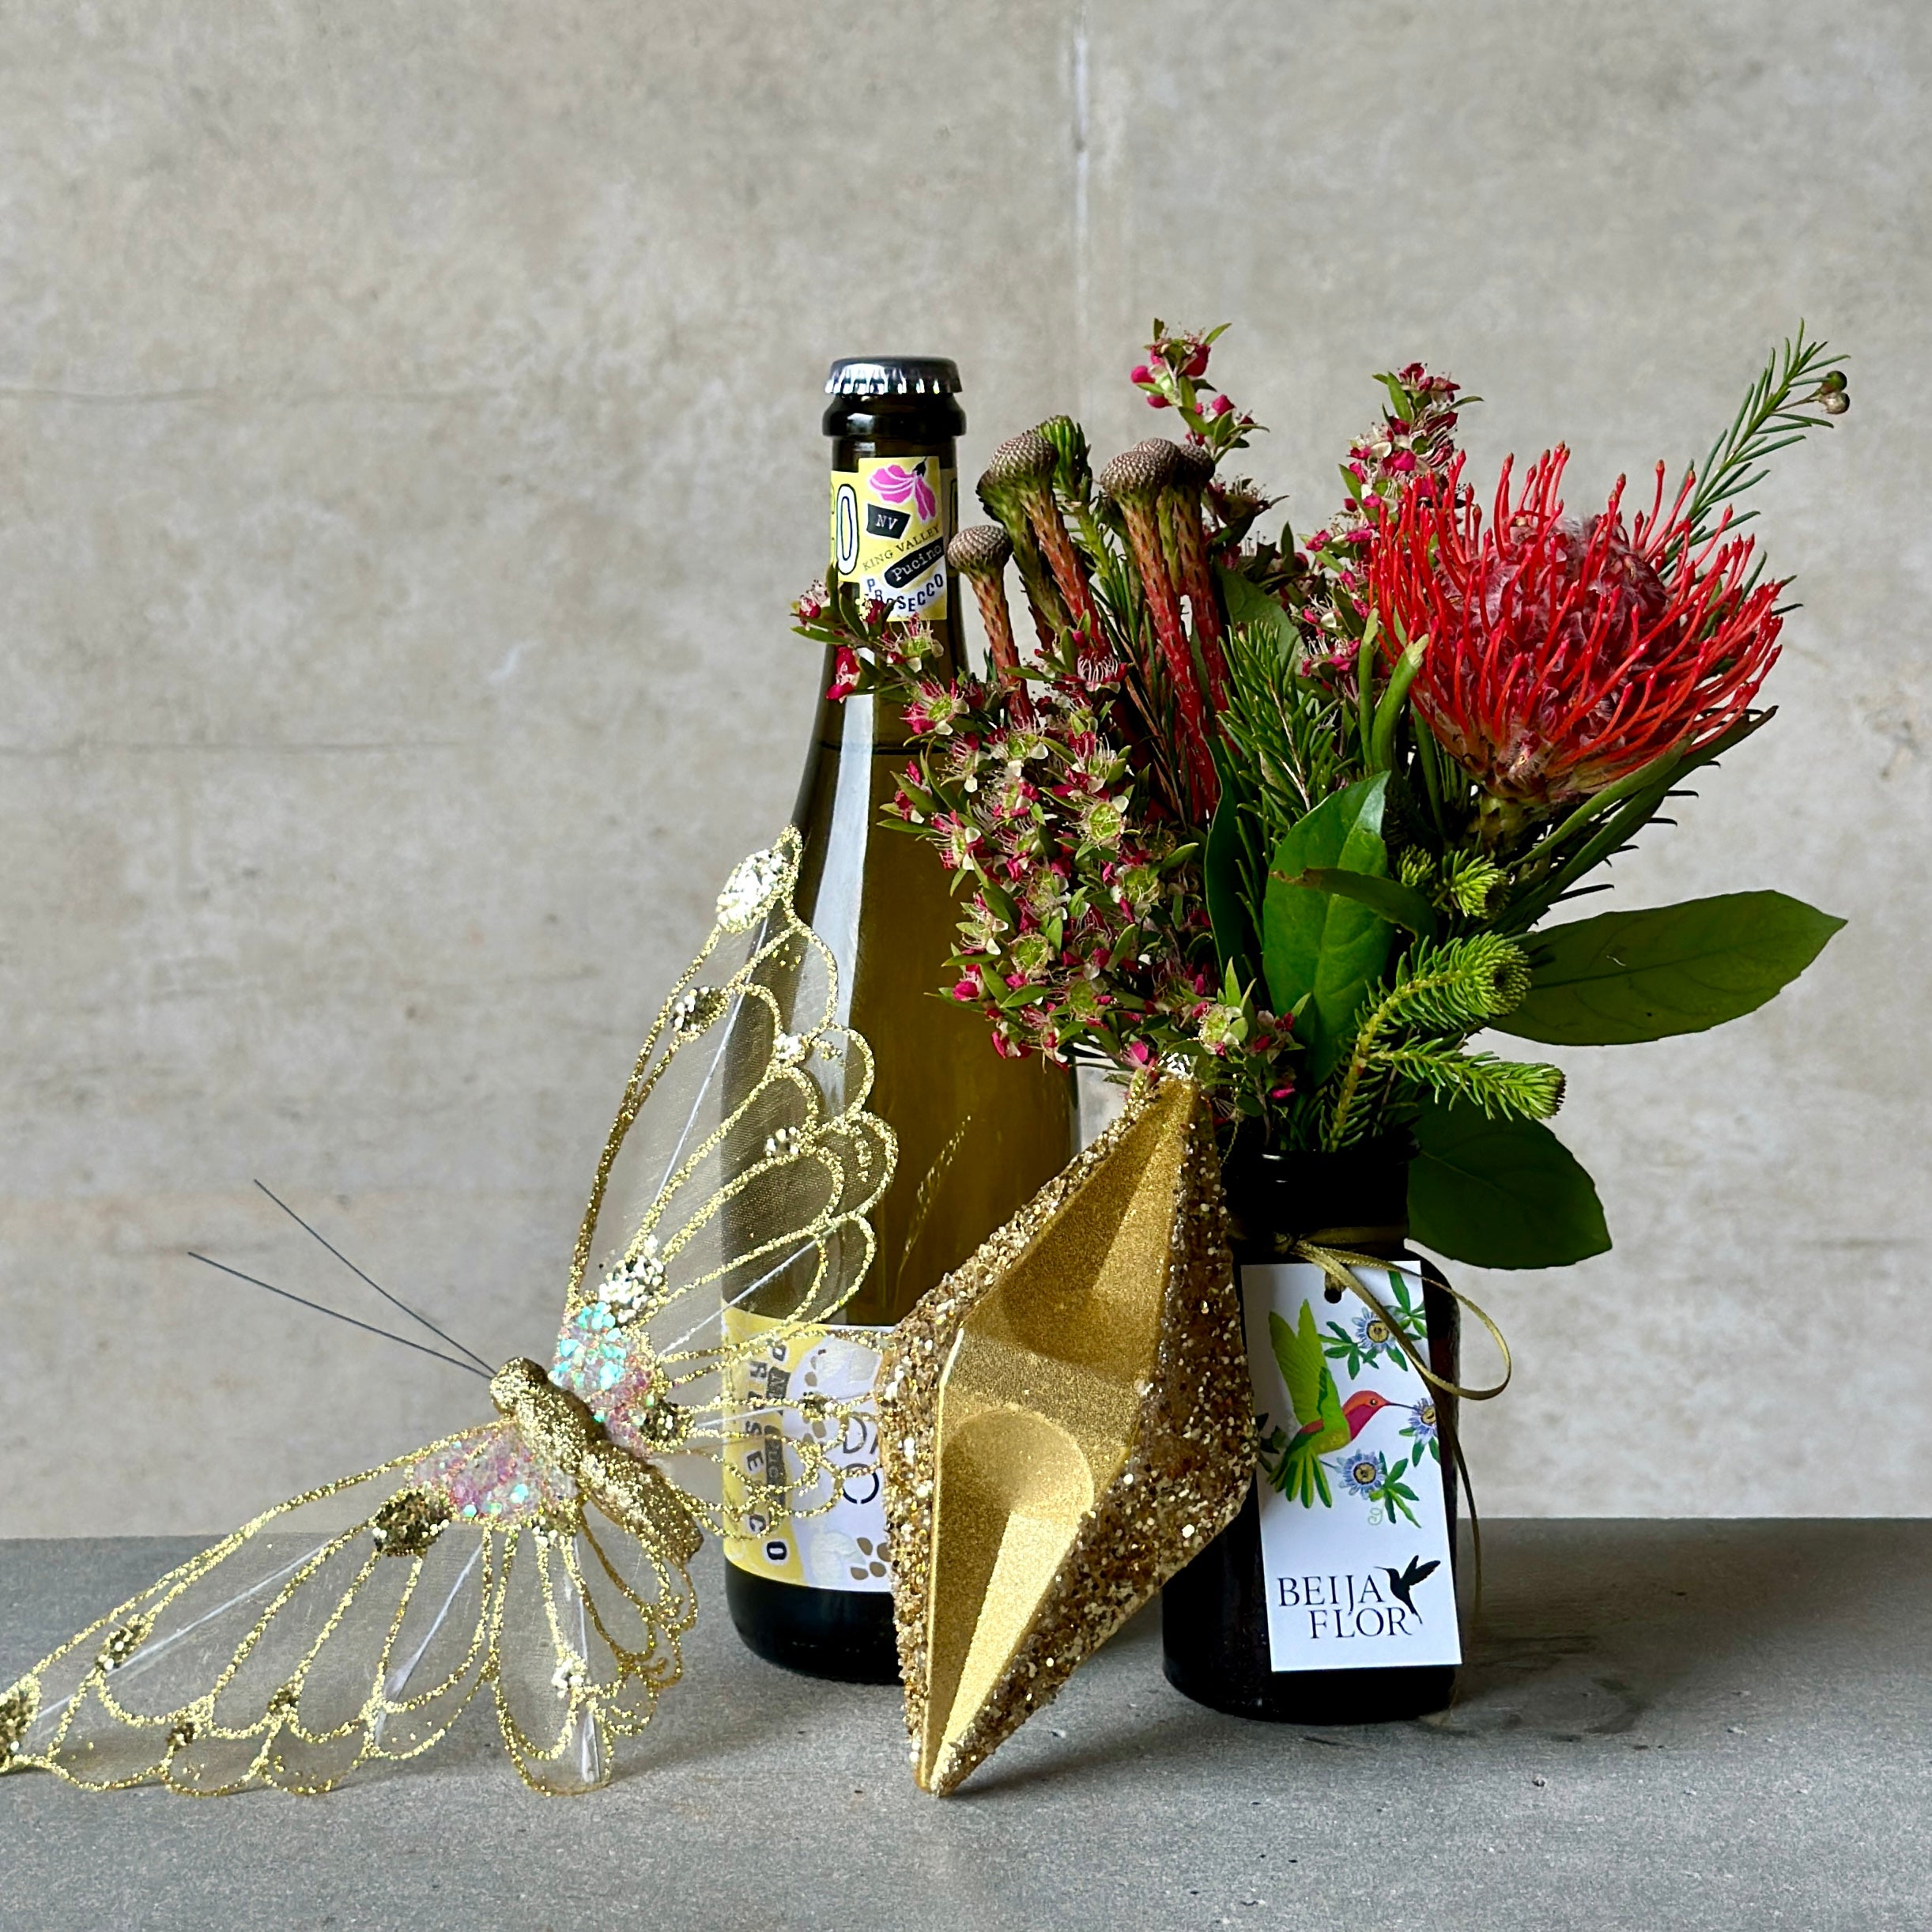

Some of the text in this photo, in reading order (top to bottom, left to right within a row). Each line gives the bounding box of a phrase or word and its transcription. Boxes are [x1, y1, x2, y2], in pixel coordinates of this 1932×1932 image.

[876, 514, 898, 530] NV
[862, 523, 939, 571] KING VALLEY
[892, 545, 941, 581] Pucino
[1277, 1574, 1386, 1616] BEIJA
[1308, 1607, 1413, 1639] FLOR
